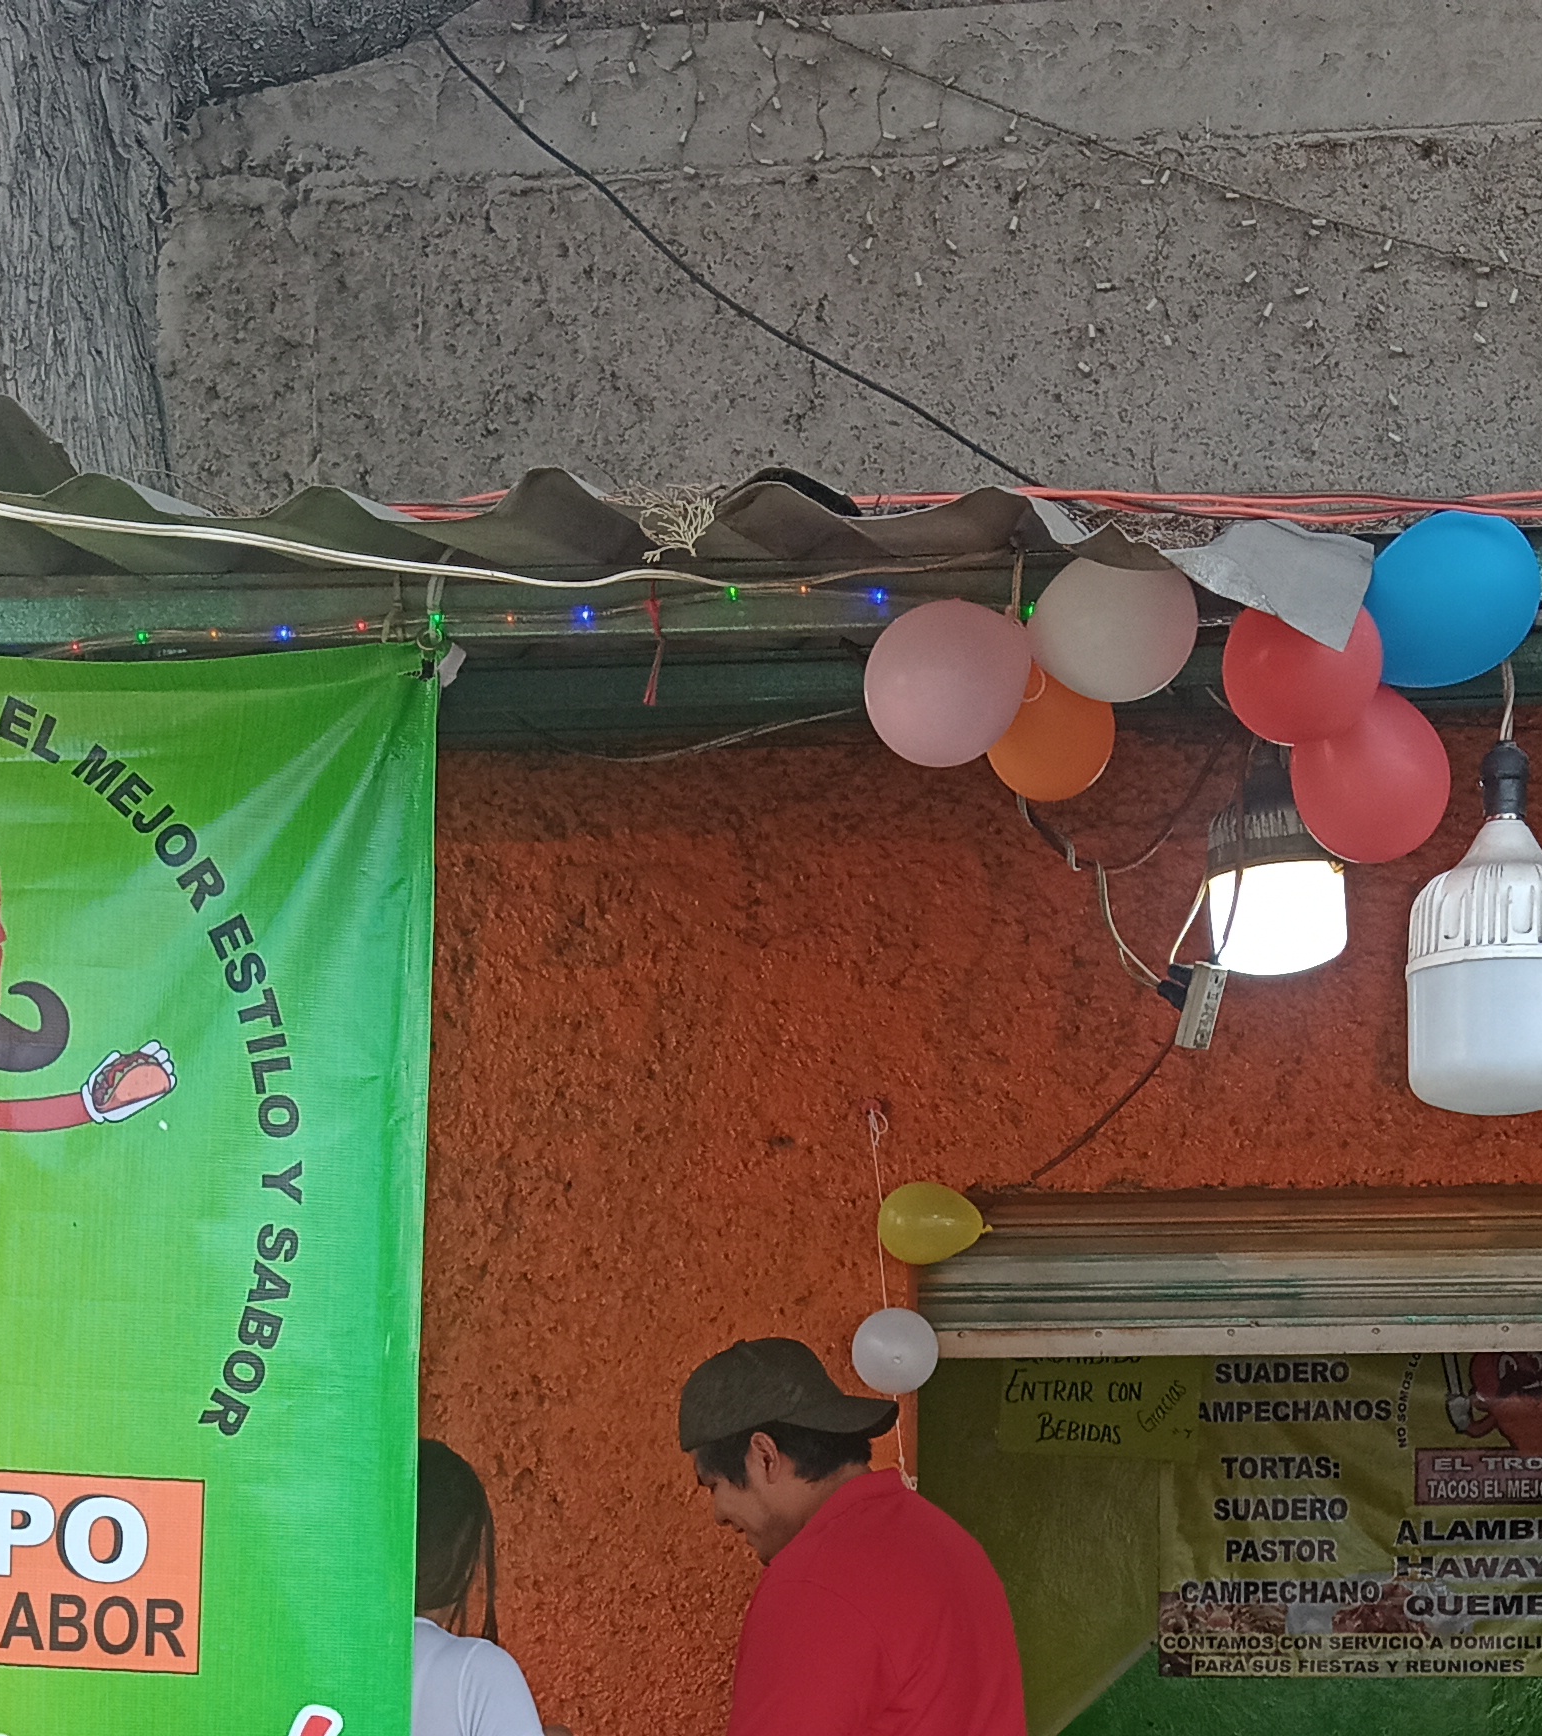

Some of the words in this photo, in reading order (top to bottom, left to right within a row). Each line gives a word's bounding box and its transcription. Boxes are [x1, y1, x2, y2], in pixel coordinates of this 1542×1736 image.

[71, 743, 228, 913] MEJOR
[206, 912, 301, 1139] ESTILO
[260, 1159, 303, 1206] Y
[197, 1221, 300, 1437] SABOR
[1216, 1360, 1349, 1386] SUADERO
[1109, 1380, 1142, 1403] CON
[1398, 1371, 1414, 1422] SOMOS
[1197, 1398, 1392, 1424] AMPECHANOS
[1396, 1426, 1408, 1449] NO
[1221, 1455, 1340, 1481] TORTAS:
[1434, 1458, 1471, 1471] EL
[1428, 1480, 1479, 1498] TACOS
[1483, 1480, 1504, 1498] EL
[1214, 1496, 1347, 1522] SUADERO
[1225, 1537, 1336, 1564] PASTOR
[1181, 1579, 1382, 1606] CAMPECHANO
[1162, 1635, 1274, 1651] CONTAMOS
[1280, 1635, 1322, 1651] CON
[1329, 1635, 1420, 1651] SERVICIO
[1427, 1635, 1444, 1651] A
[1194, 1658, 1247, 1673] PARA
[1252, 1658, 1293, 1673] SUS
[1299, 1658, 1377, 1673] FIESTAS
[1381, 1658, 1398, 1673] Y
[1402, 1658, 1525, 1673] REUNIONES
